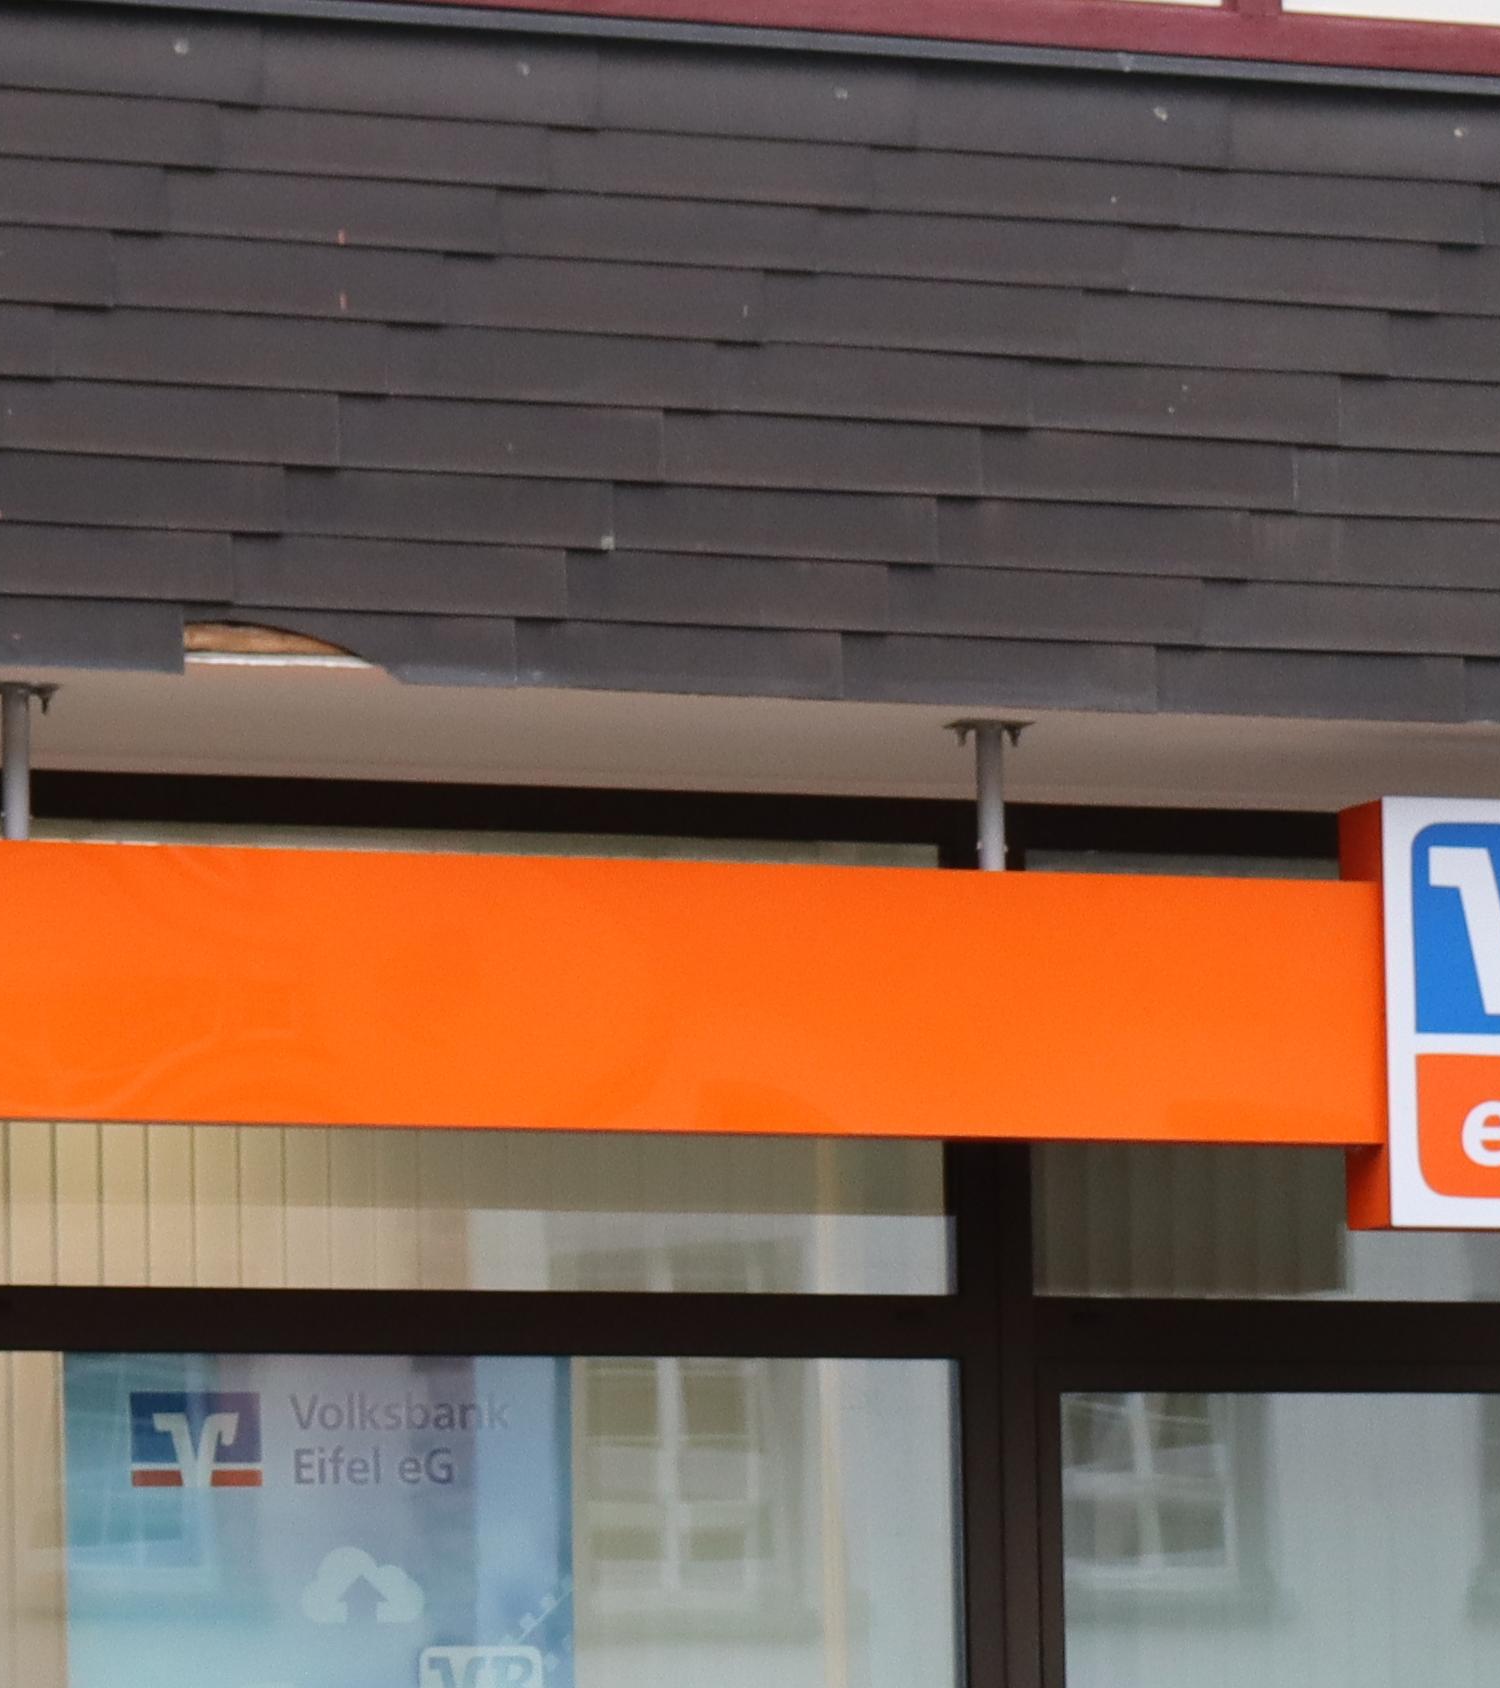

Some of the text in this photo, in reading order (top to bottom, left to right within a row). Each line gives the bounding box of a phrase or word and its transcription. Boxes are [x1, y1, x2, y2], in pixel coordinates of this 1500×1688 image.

[289, 1391, 510, 1431] Volksbank
[294, 1445, 453, 1485] Eifel eG
